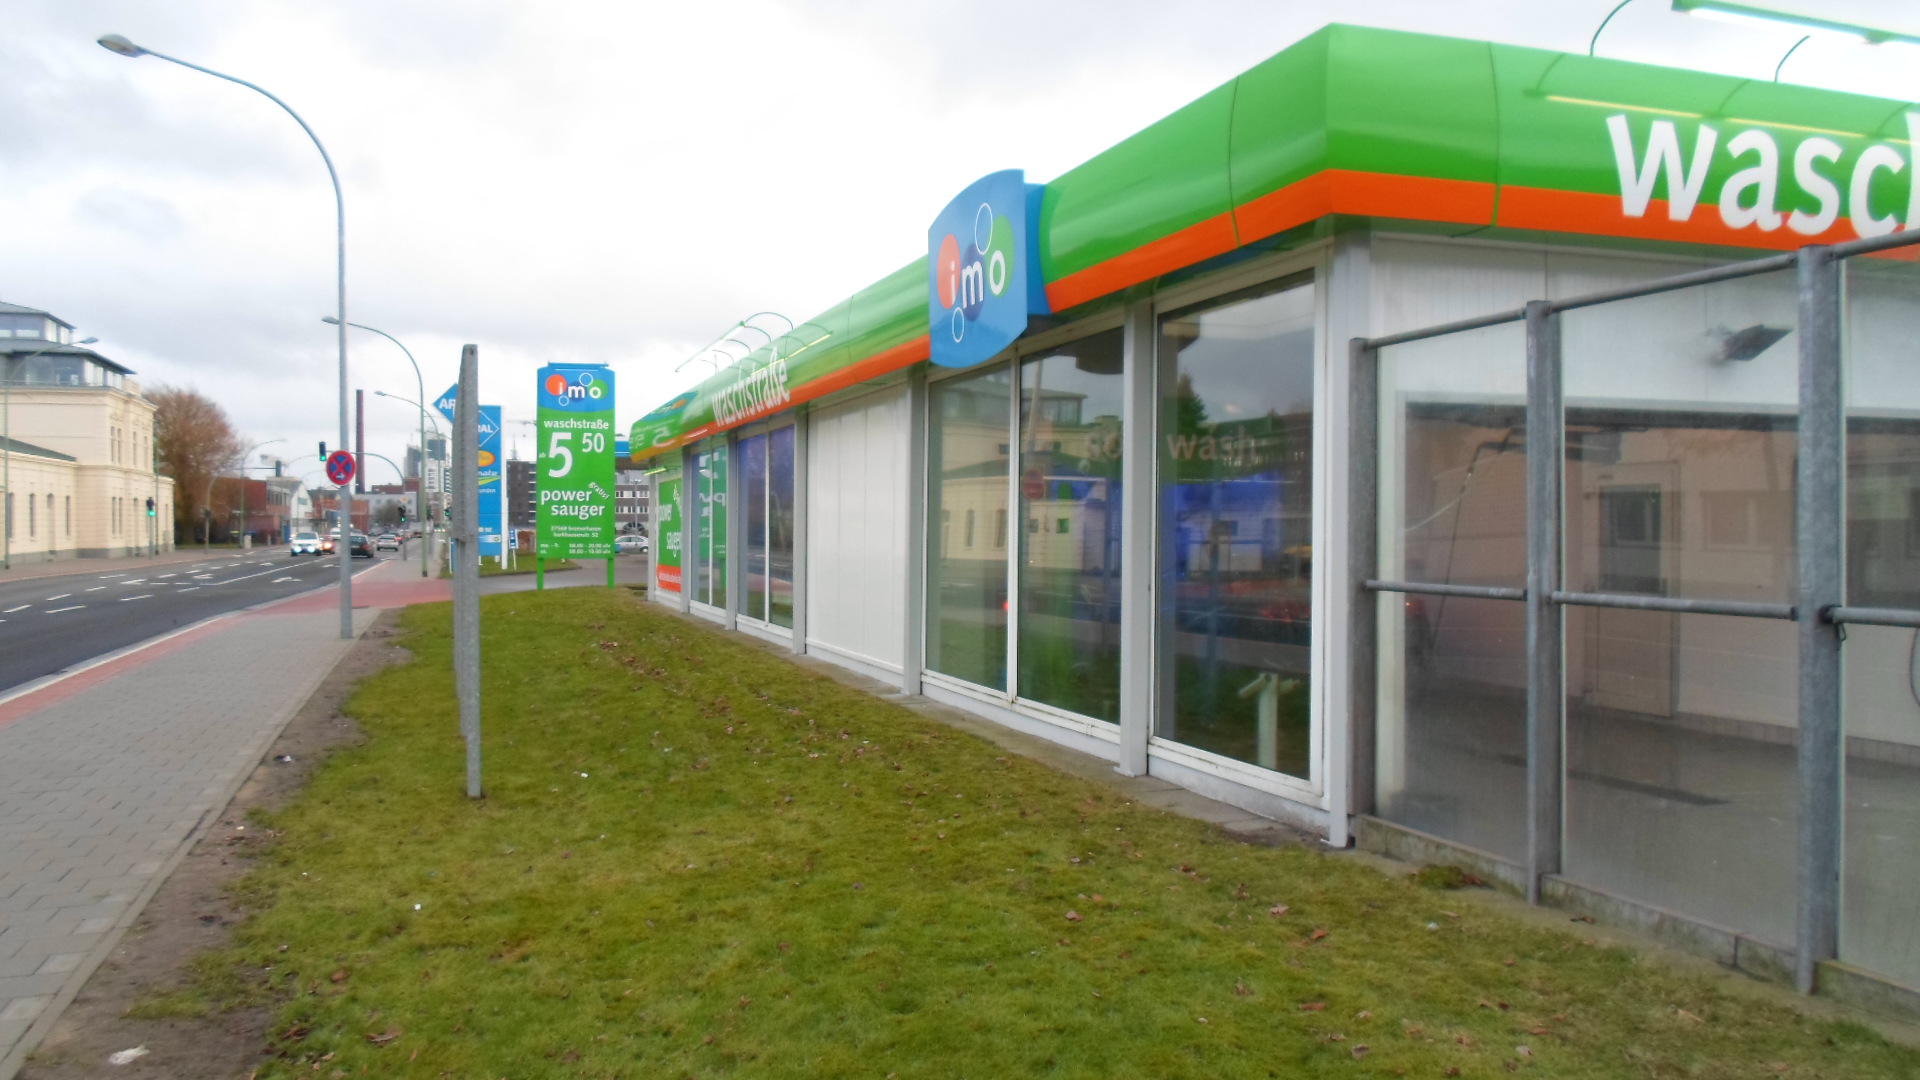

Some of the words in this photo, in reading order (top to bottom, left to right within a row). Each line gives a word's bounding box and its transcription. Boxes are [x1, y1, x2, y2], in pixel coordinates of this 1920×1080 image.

[951, 249, 1006, 309] imo
[558, 381, 602, 398] imo
[712, 347, 791, 427] waschstraße
[543, 417, 609, 430] waschstraße
[548, 431, 573, 478] 5
[582, 432, 606, 453] 50
[1165, 424, 1259, 462] wash
[541, 489, 592, 505] power
[551, 504, 606, 521] sauger
